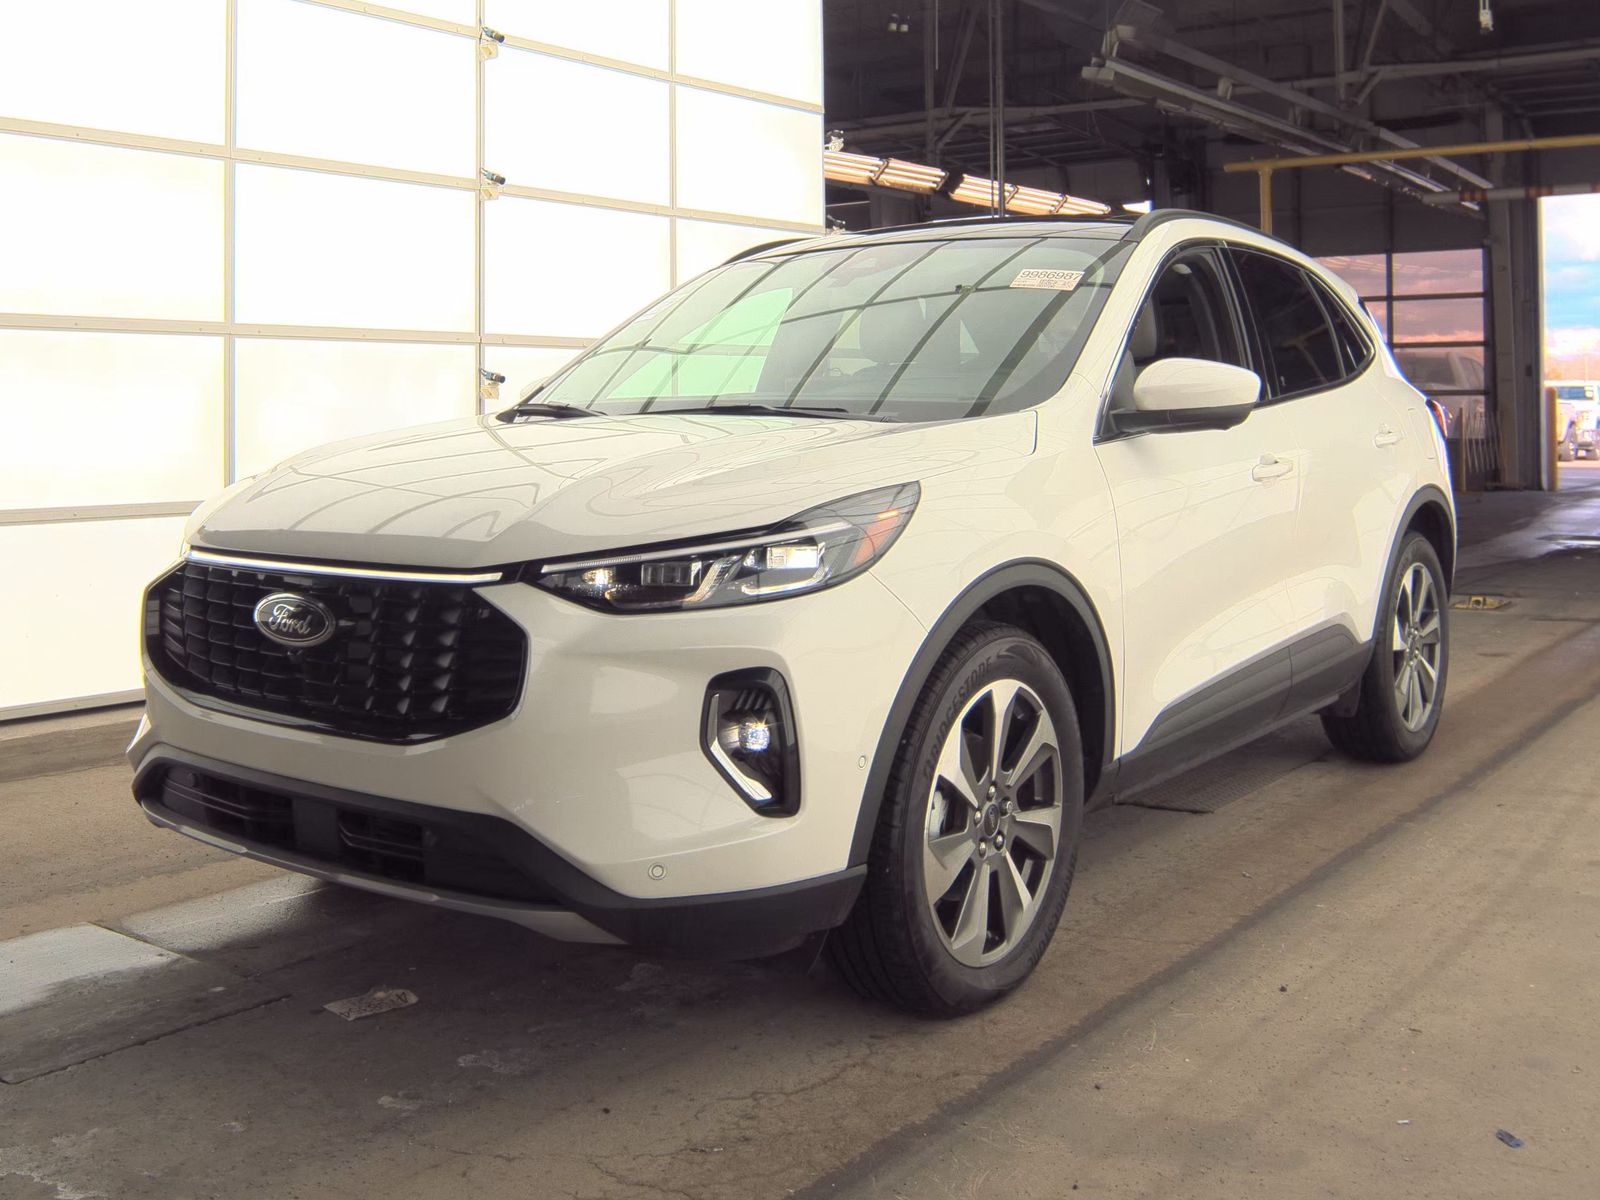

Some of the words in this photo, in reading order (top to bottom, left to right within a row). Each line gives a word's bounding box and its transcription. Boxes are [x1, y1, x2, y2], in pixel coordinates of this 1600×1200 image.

[1020, 270, 1083, 281] 9986987
[268, 603, 312, 635] Ford
[923, 655, 993, 777] BRIDGESTONE
